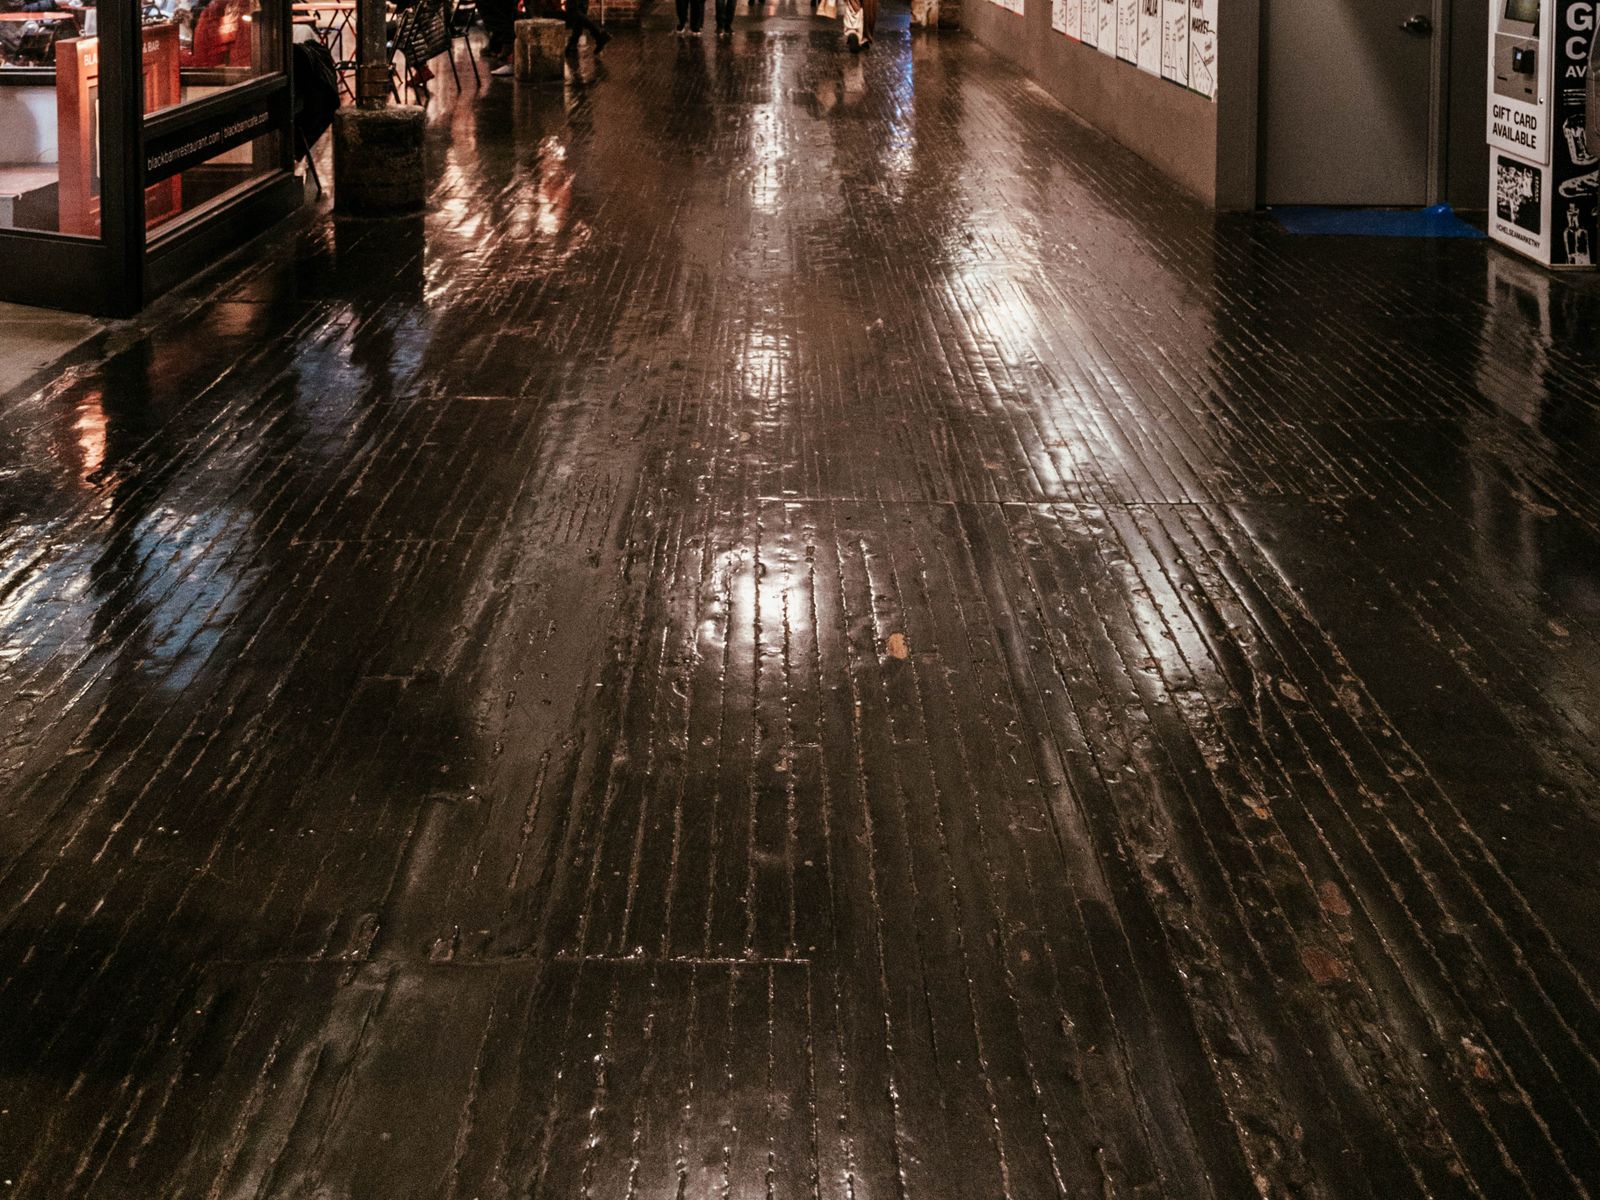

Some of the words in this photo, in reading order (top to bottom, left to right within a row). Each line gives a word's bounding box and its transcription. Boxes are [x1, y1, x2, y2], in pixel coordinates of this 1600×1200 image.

[1493, 104, 1511, 123] GIFT
[1513, 110, 1537, 131] CARD
[1492, 122, 1537, 150] AVAILABLE
